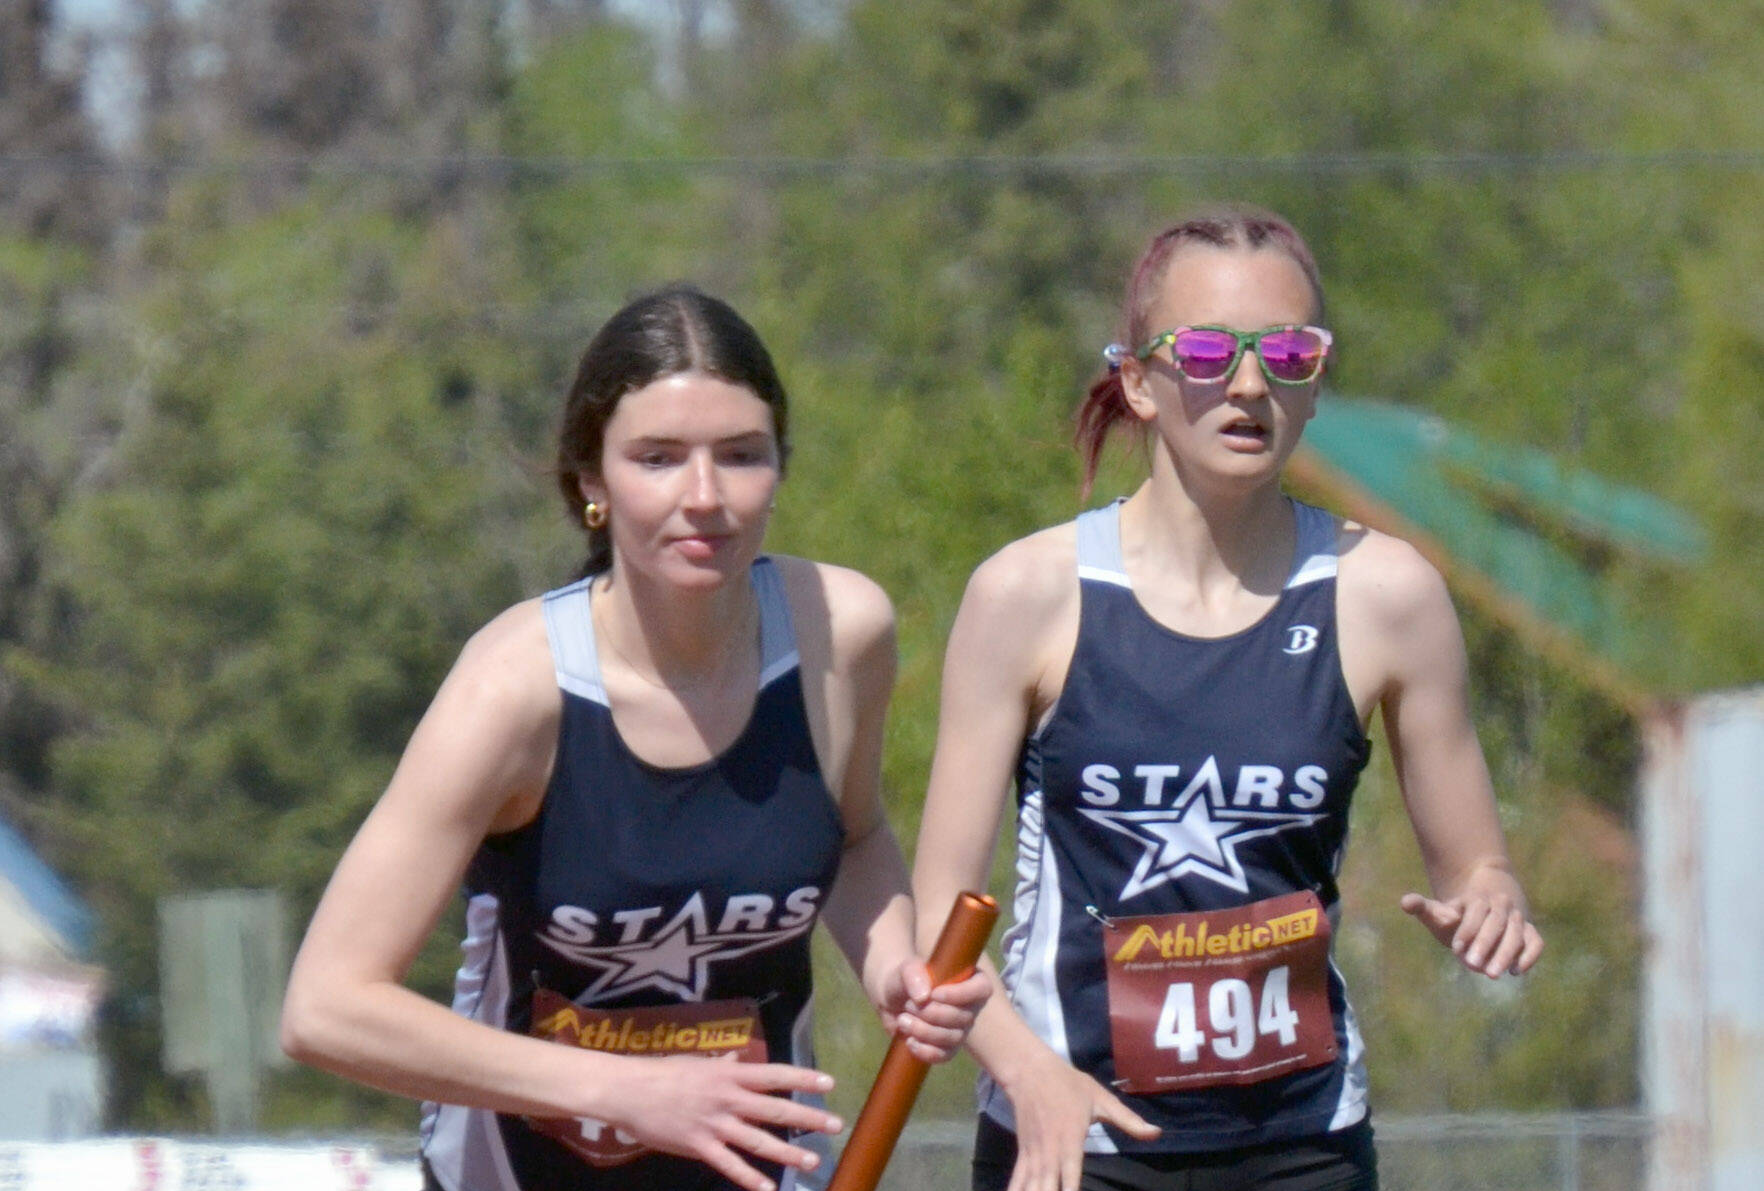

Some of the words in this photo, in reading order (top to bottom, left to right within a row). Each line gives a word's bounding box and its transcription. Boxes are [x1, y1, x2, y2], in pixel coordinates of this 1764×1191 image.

[1081, 754, 1328, 808] STARS
[548, 886, 821, 945] STARS
[1155, 966, 1299, 1062] 494
